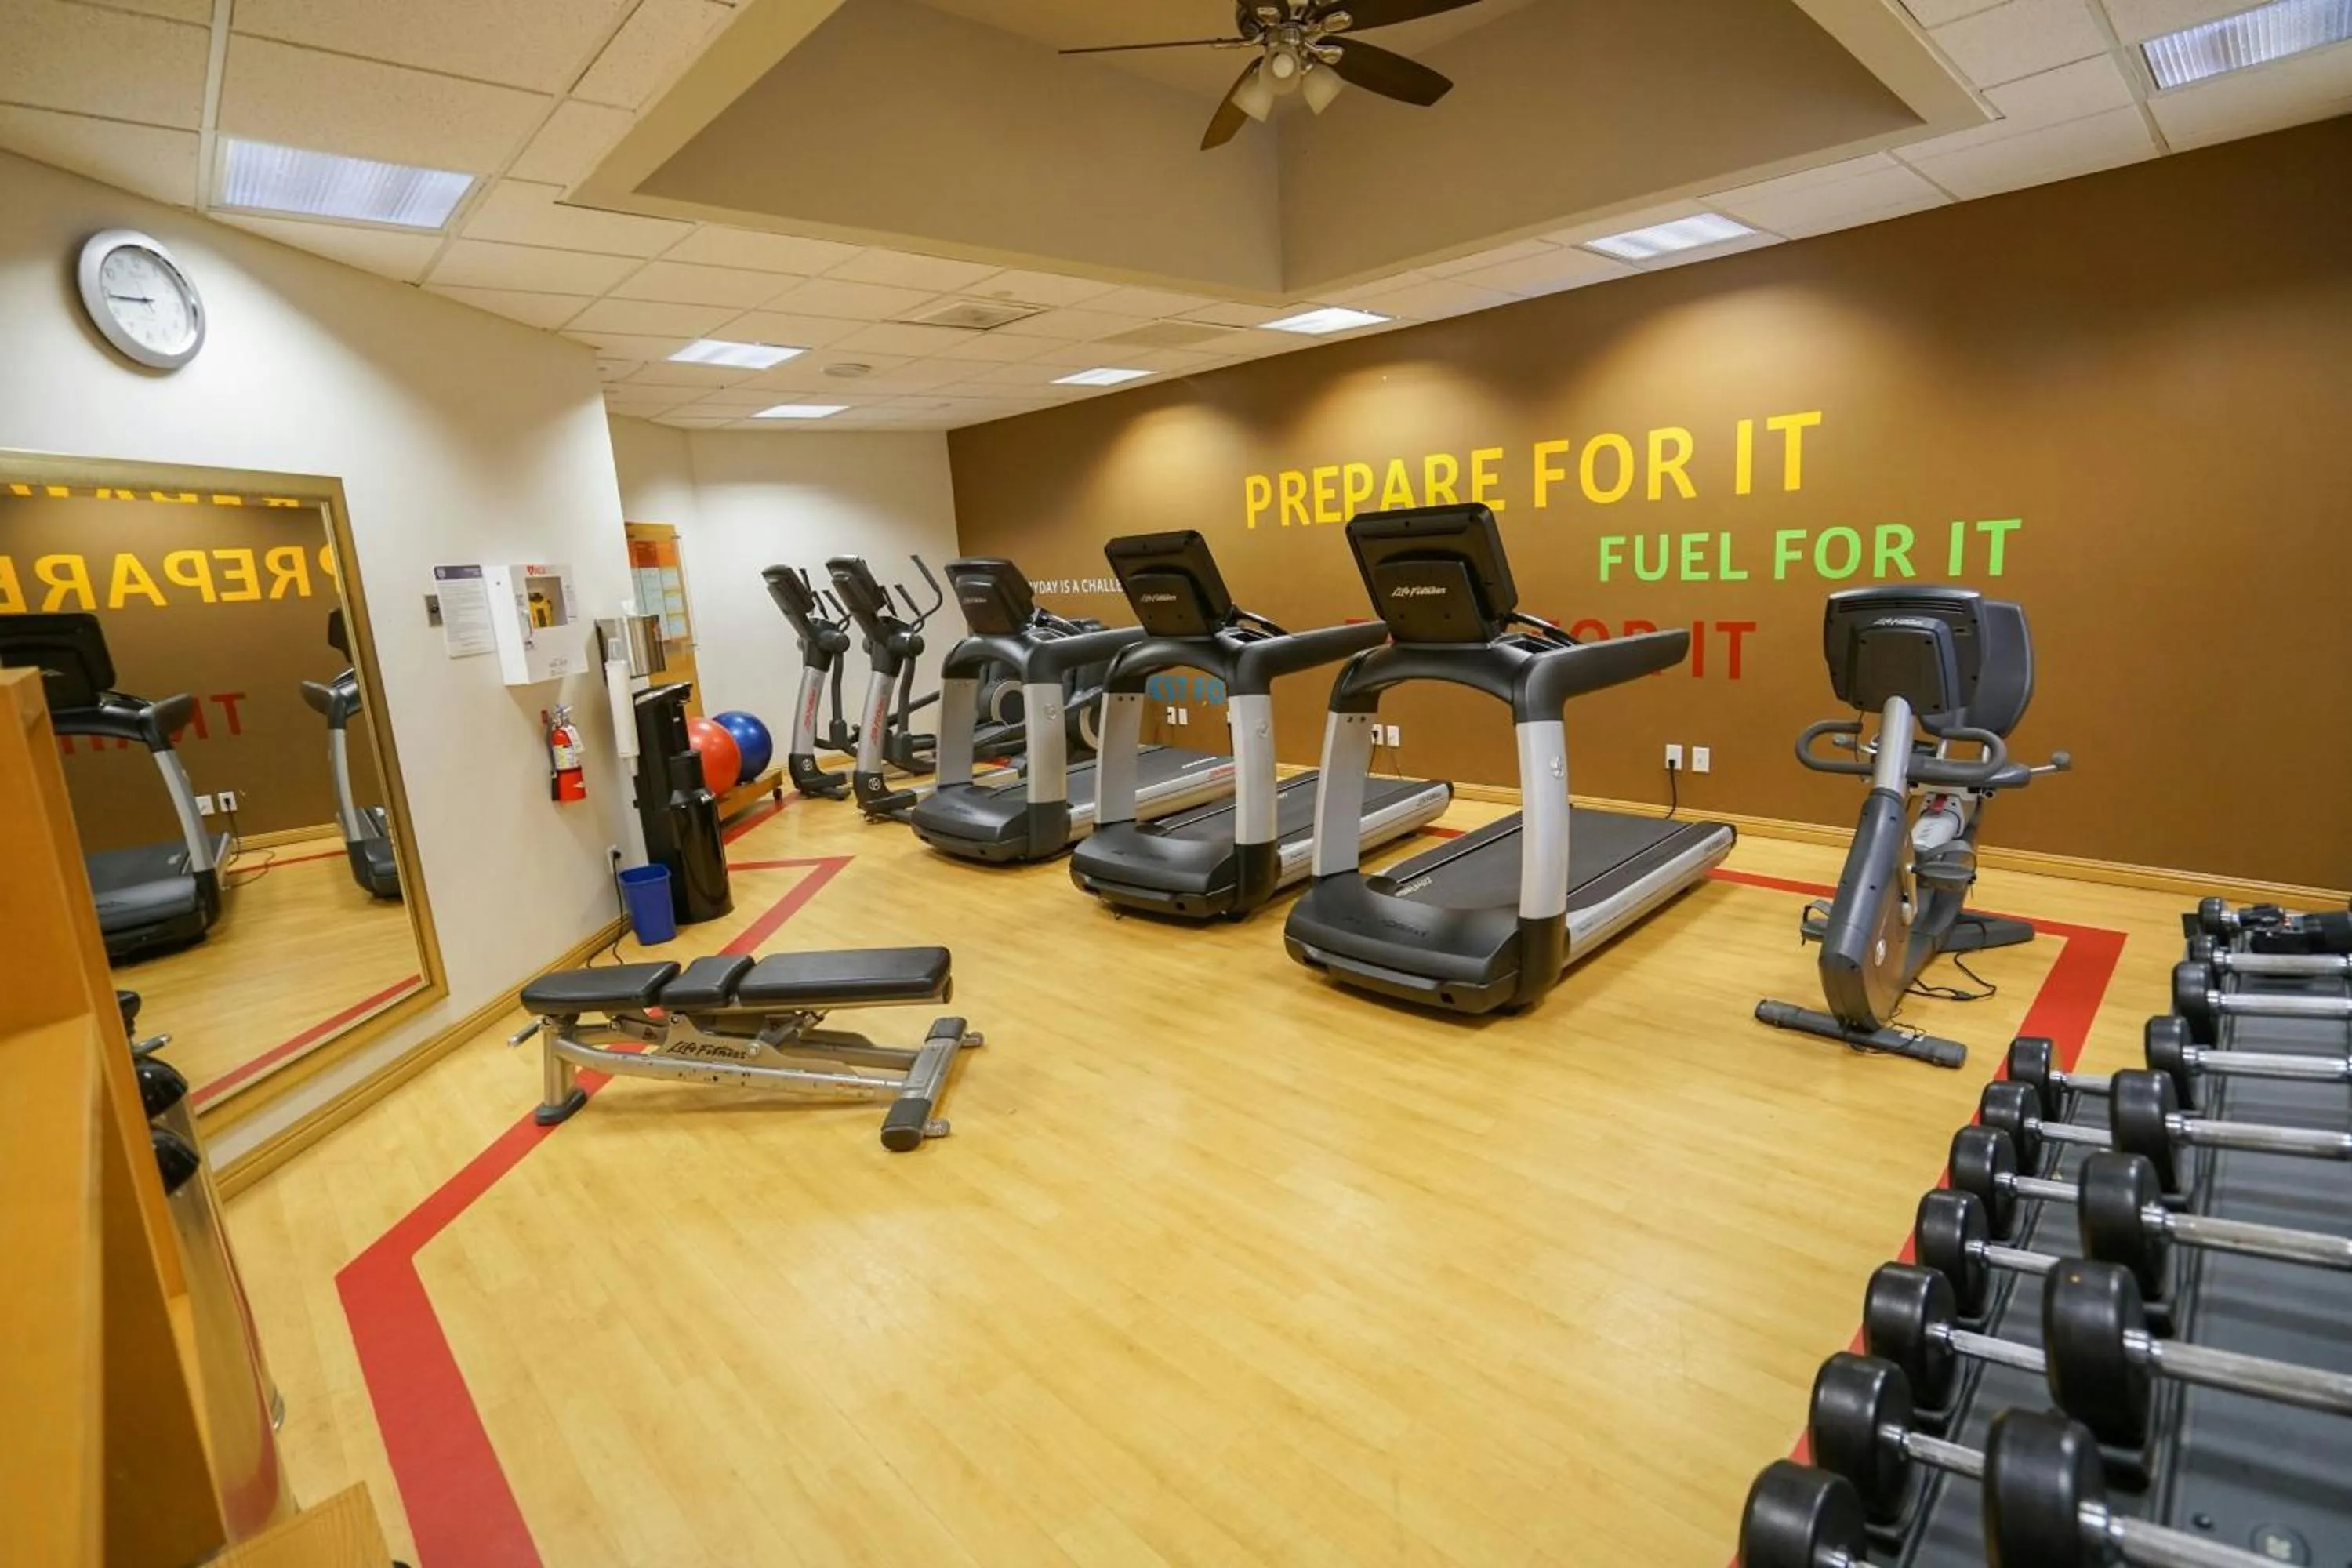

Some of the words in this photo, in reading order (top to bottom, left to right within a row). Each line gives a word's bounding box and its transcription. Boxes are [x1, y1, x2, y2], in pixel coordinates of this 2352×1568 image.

[1245, 447, 1506, 528] PREPARE
[1533, 426, 1696, 508] FOR
[1735, 411, 1823, 495] IT
[1599, 532, 1748, 582] FUEL
[1773, 524, 1915, 579] FOR
[1948, 517, 2022, 577] IT
[1029, 581, 1058, 594] YDAY
[1060, 580, 1070, 593] IS
[1072, 579, 1080, 593] A
[1081, 579, 1123, 593] CHALLE
[1691, 621, 1756, 680] IT
[666, 1040, 697, 1054] Life
[694, 1044, 747, 1059] Fitness
